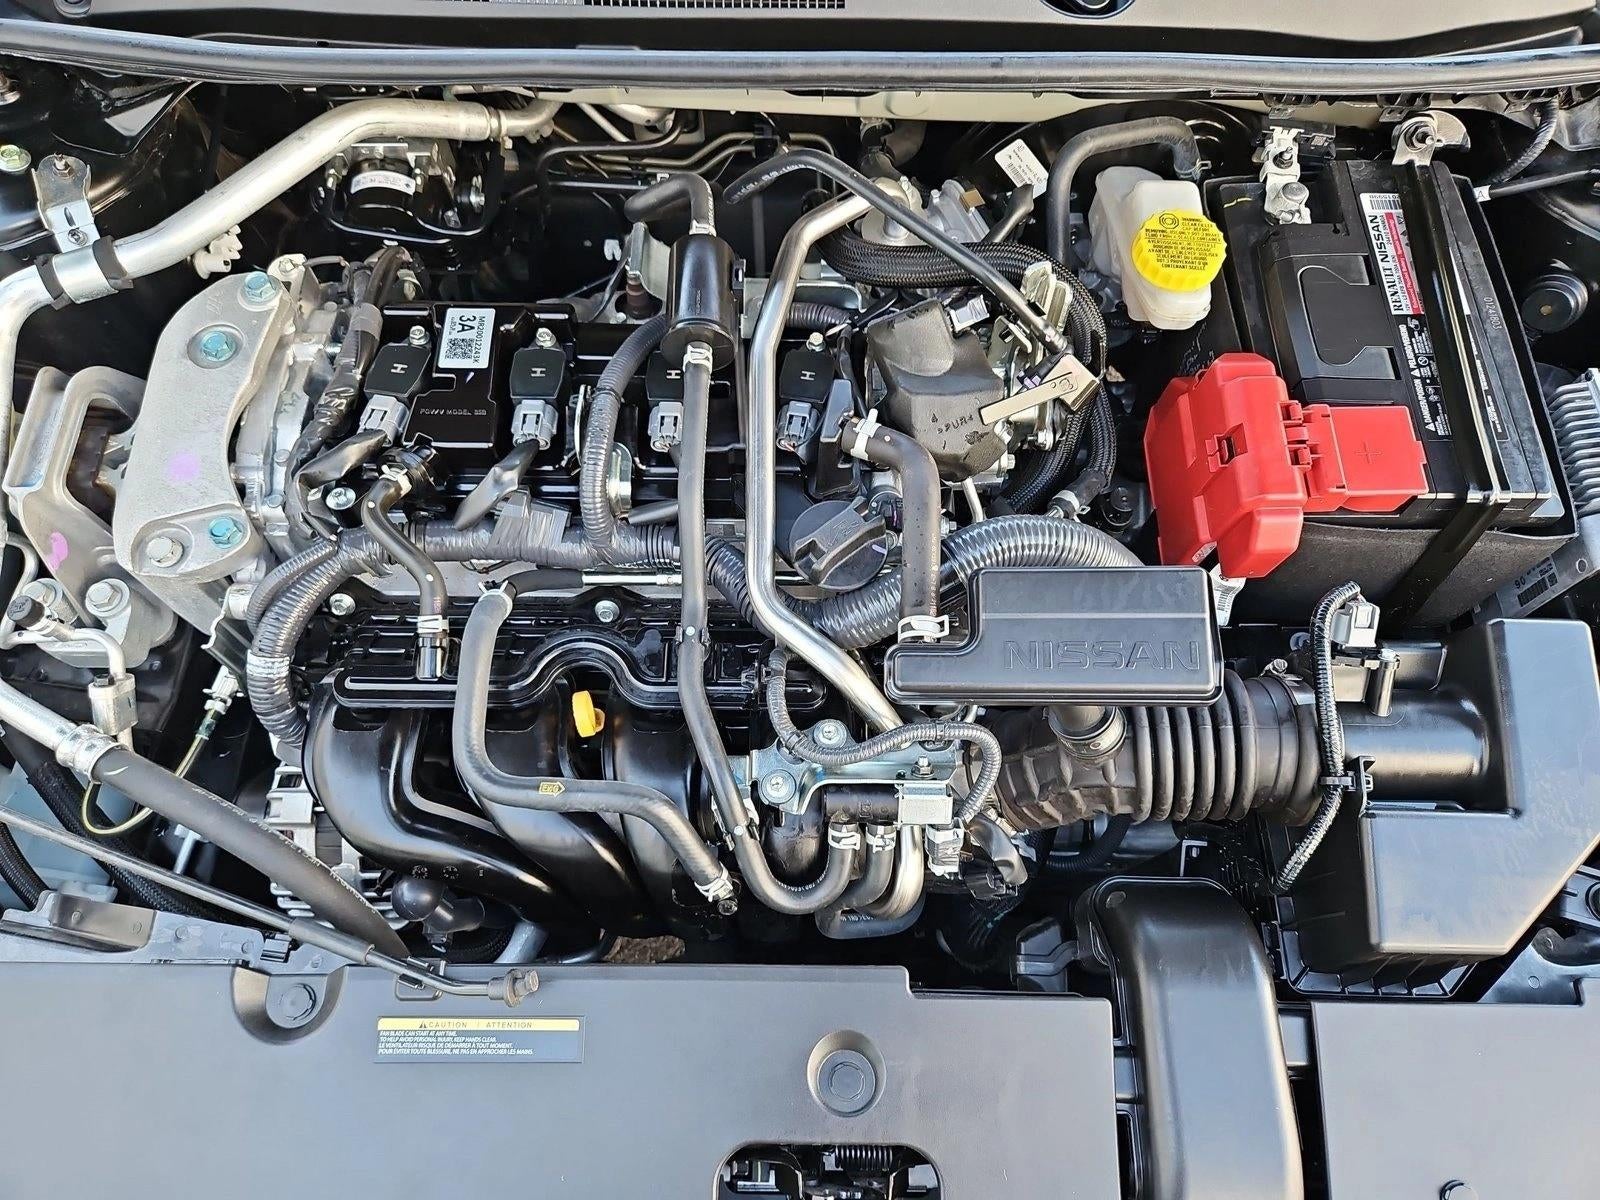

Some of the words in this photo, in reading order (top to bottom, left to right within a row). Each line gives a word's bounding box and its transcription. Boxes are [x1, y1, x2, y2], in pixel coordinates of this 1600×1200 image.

[1368, 214, 1390, 263] NISSAN
[1382, 267, 1404, 311] RENAULT
[457, 315, 476, 333] 3A
[1004, 640, 1200, 670] NISSAN
